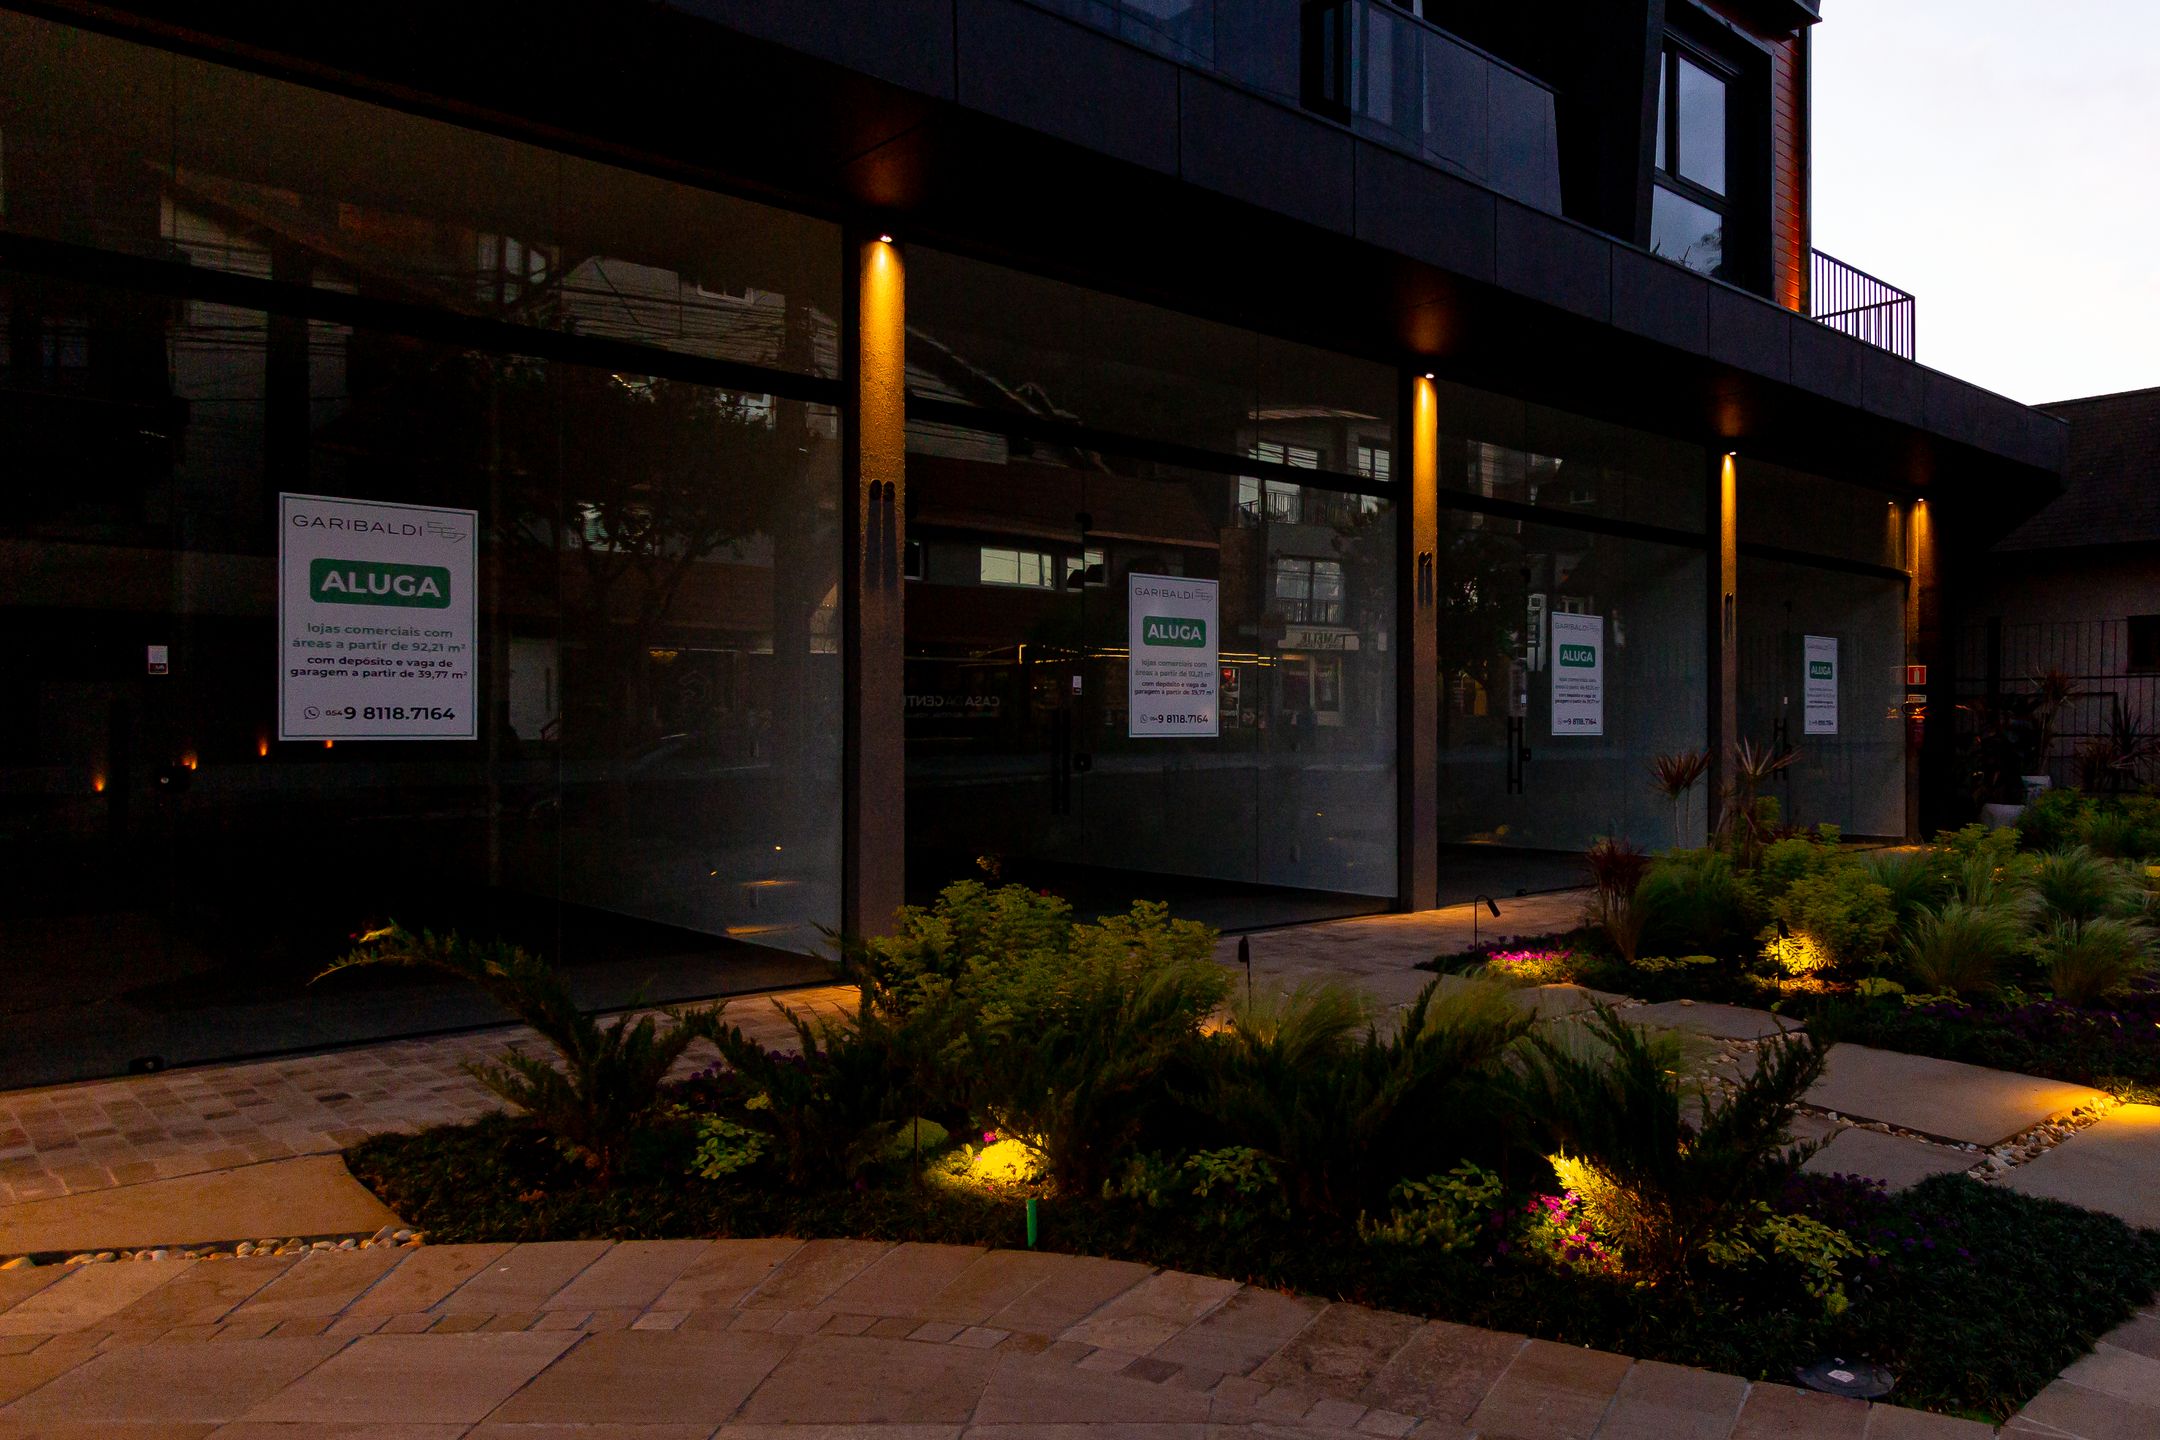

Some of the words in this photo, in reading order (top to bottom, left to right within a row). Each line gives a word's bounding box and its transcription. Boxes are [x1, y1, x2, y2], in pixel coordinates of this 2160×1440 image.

[292, 515, 423, 537] GARIBALDI
[320, 570, 441, 598] ALUGA
[1134, 587, 1194, 599] GARIBALDI
[307, 622, 341, 639] lojas
[344, 624, 421, 637] comerciais
[424, 629, 453, 638] com
[1147, 623, 1202, 640] ALUGA
[292, 637, 332, 649] áreas
[336, 641, 344, 649] a
[348, 639, 388, 653] partir
[391, 641, 409, 651] de
[412, 642, 444, 653] 92,21
[307, 656, 335, 665] com
[338, 655, 393, 668] depósito
[407, 659, 435, 669] vaga
[438, 658, 453, 668] de
[1562, 650, 1594, 662] ALUGA
[290, 668, 348, 678] garagem
[351, 669, 359, 677] a
[362, 668, 397, 679] partir
[399, 669, 415, 678] de
[418, 670, 448, 680] 39,77
[343, 706, 356, 720] 9
[363, 706, 455, 720] 8118.7164
[1166, 714, 1208, 723] 8118.7164
